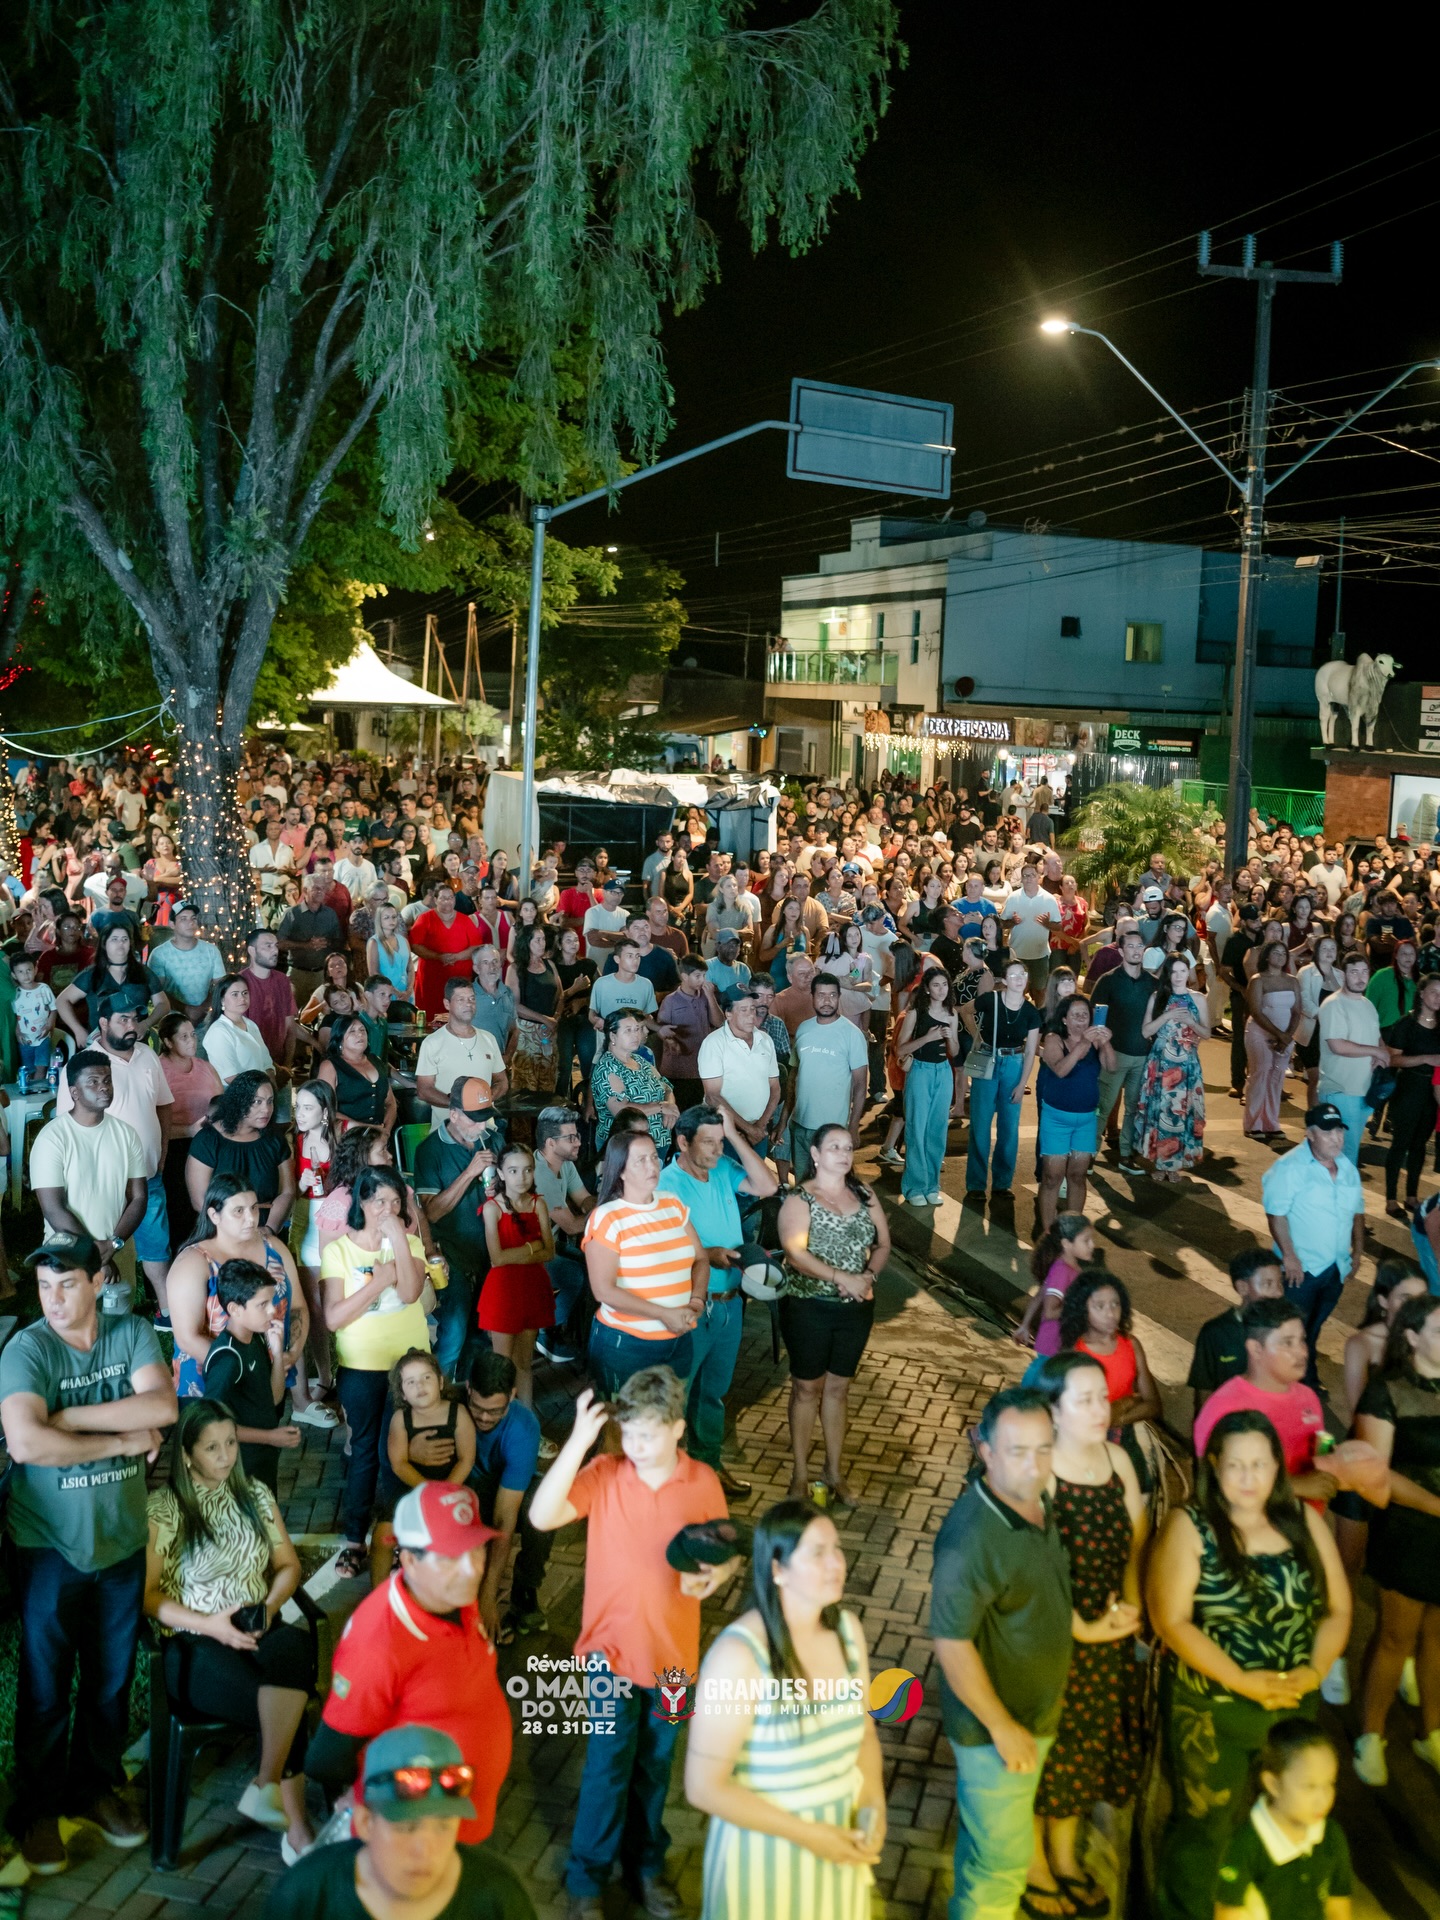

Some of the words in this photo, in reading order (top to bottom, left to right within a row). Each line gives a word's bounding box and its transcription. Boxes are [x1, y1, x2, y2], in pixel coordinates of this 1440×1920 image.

[929, 718, 953, 737] DECK
[954, 719, 1010, 740] PETISCARIA
[1114, 729, 1141, 740] DECK
[103, 1363, 126, 1377] DIST
[61, 1475, 88, 1489] DIST
